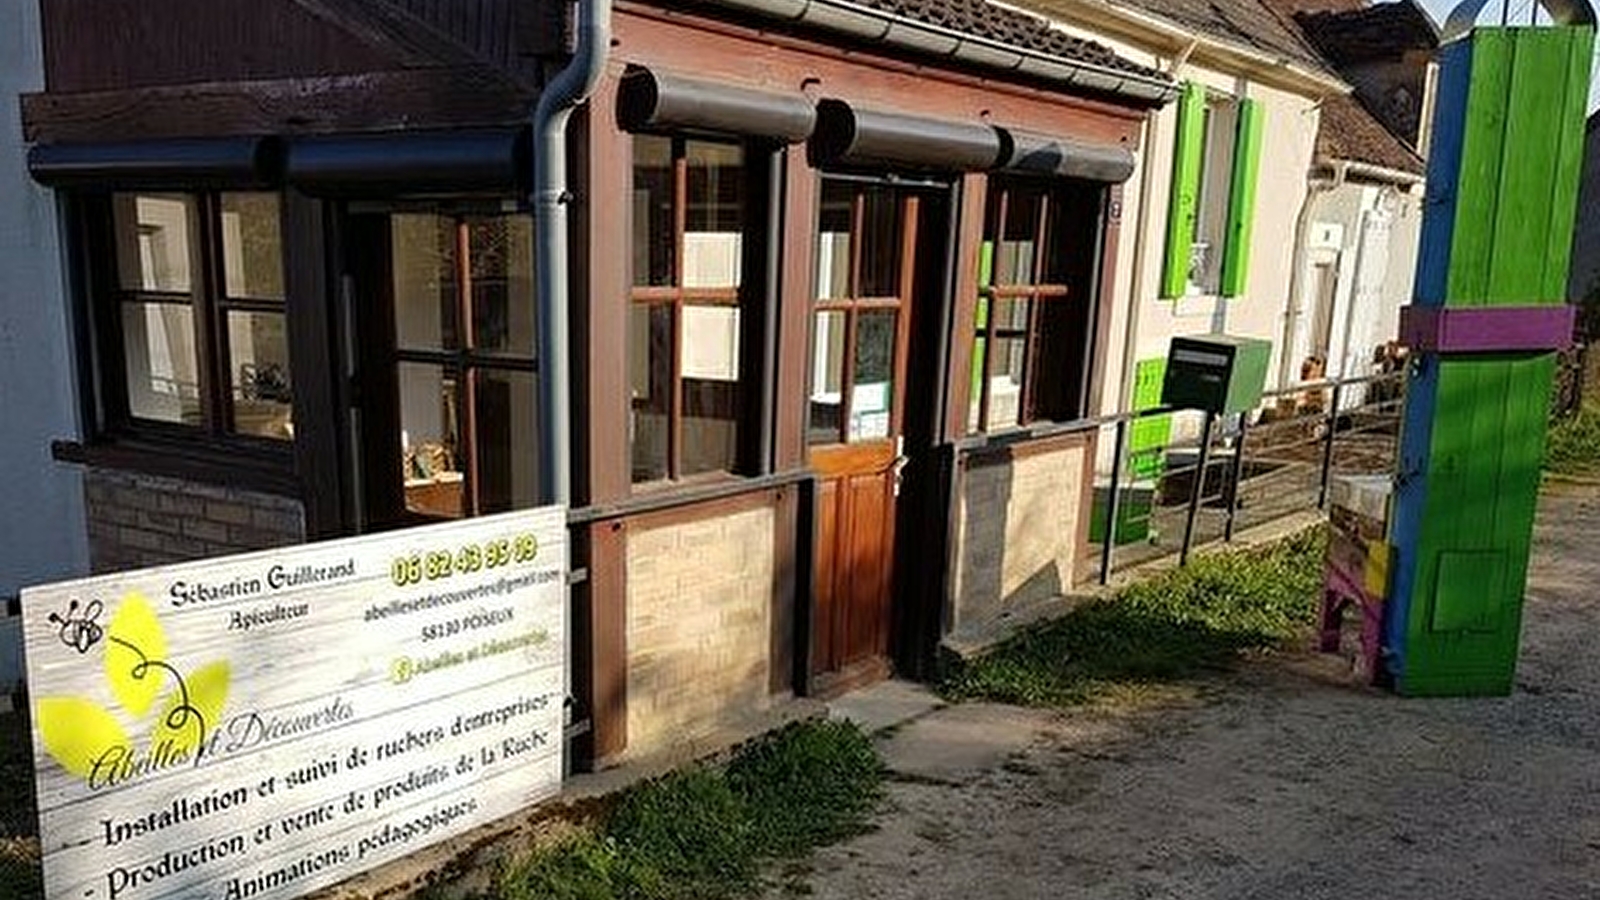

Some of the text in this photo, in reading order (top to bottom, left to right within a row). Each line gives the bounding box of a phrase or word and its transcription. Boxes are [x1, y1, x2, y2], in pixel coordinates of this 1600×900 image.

[170, 558, 355, 607] Sébastien Guillerand
[392, 556, 421, 586] 06
[425, 550, 453, 579] 82
[455, 544, 482, 574] 43
[485, 540, 510, 569] 95
[228, 603, 310, 630] Apiculteur
[422, 619, 460, 643] 58130
[87, 738, 191, 791] Abeilles
[101, 786, 248, 846] Installation
[256, 777, 275, 797] et
[284, 754, 338, 789] suivi
[346, 747, 368, 770] de
[376, 727, 445, 760] ruchers
[107, 835, 246, 900] Production
[253, 824, 272, 845] et
[281, 803, 335, 835] vente
[343, 792, 365, 815] de
[373, 766, 450, 808] produits
[455, 755, 474, 775] de
[480, 745, 495, 766] la
[502, 730, 549, 759] Ruche
[223, 797, 478, 900] Animations pédagogiques
